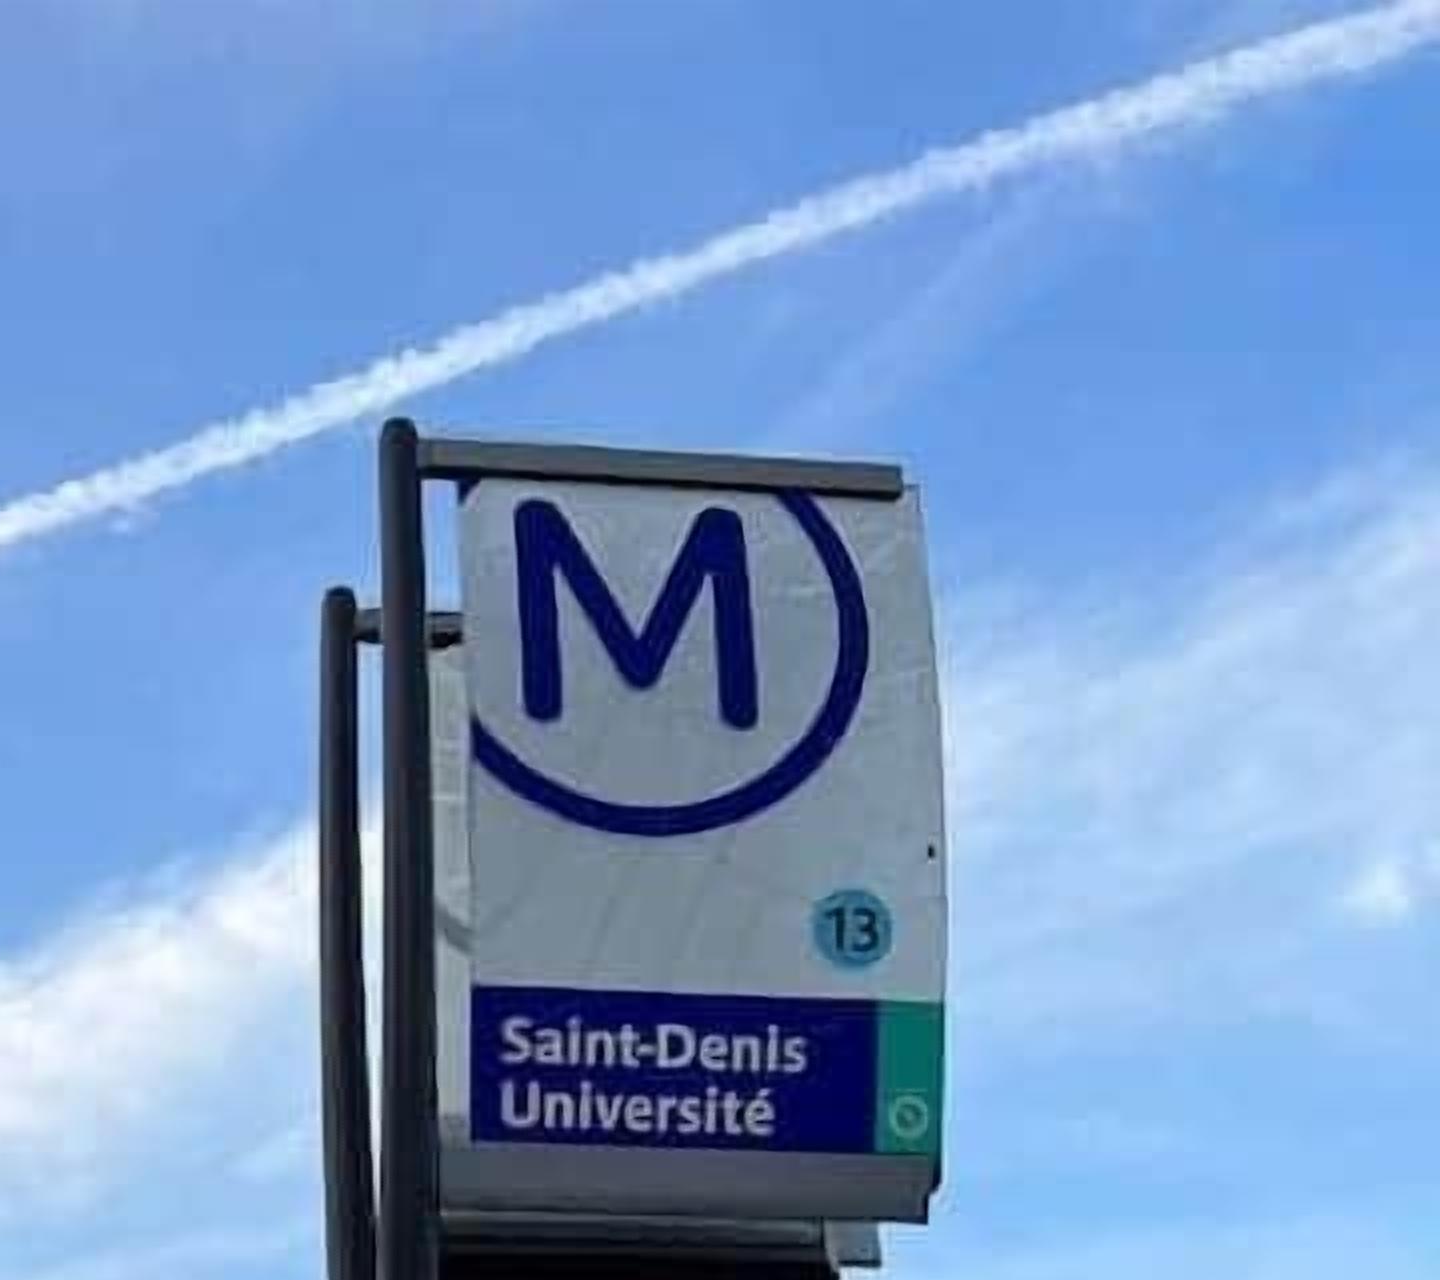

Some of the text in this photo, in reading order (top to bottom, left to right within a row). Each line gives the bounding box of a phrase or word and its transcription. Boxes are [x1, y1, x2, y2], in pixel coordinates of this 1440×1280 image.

[513, 498, 759, 730] M
[825, 906, 881, 952] 13
[500, 1015, 808, 1074] Saint-Denis
[500, 1080, 777, 1136] Université
